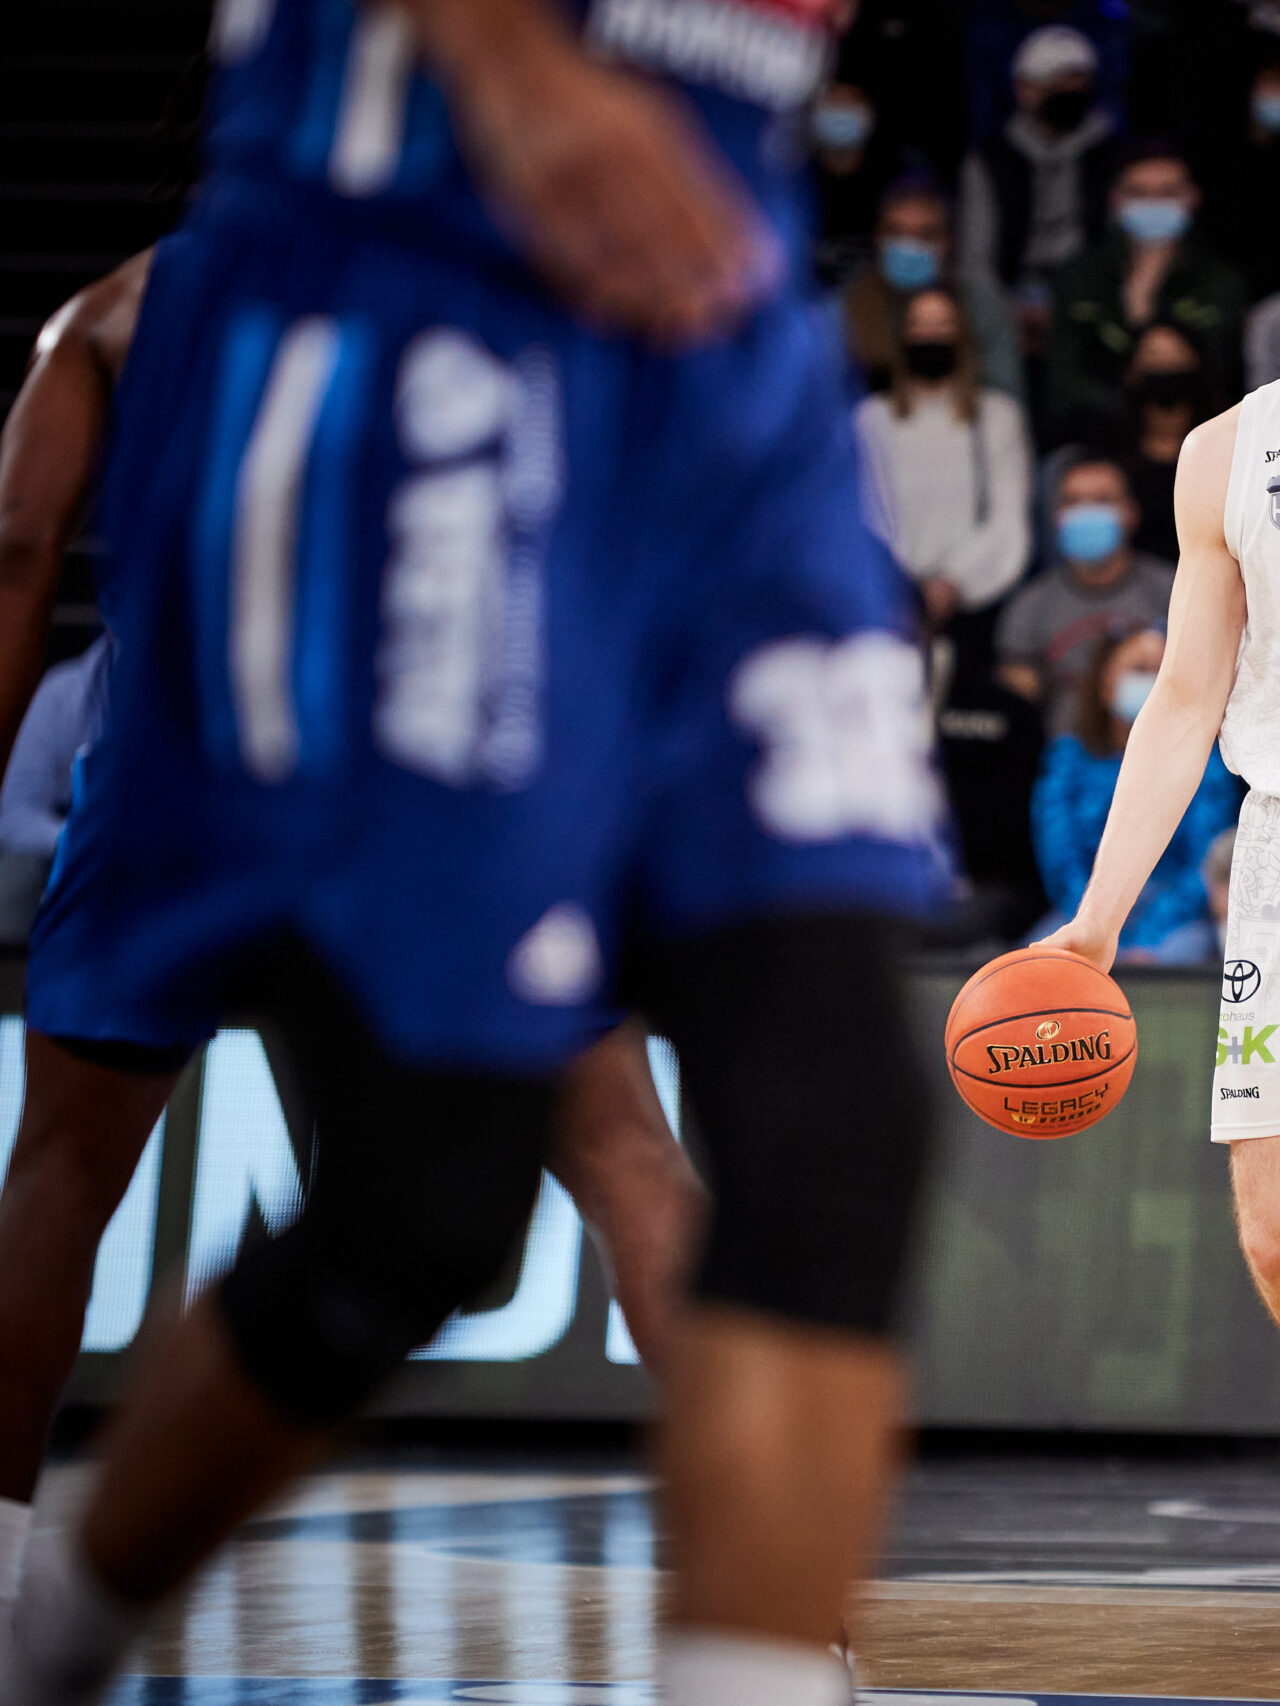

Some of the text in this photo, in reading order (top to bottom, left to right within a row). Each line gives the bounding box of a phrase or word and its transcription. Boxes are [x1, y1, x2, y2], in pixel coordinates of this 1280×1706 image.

[986, 1029, 1112, 1074] SPALDING
[1004, 1083, 1108, 1115] LEGACY
[1220, 1086, 1260, 1100] SPALDING
